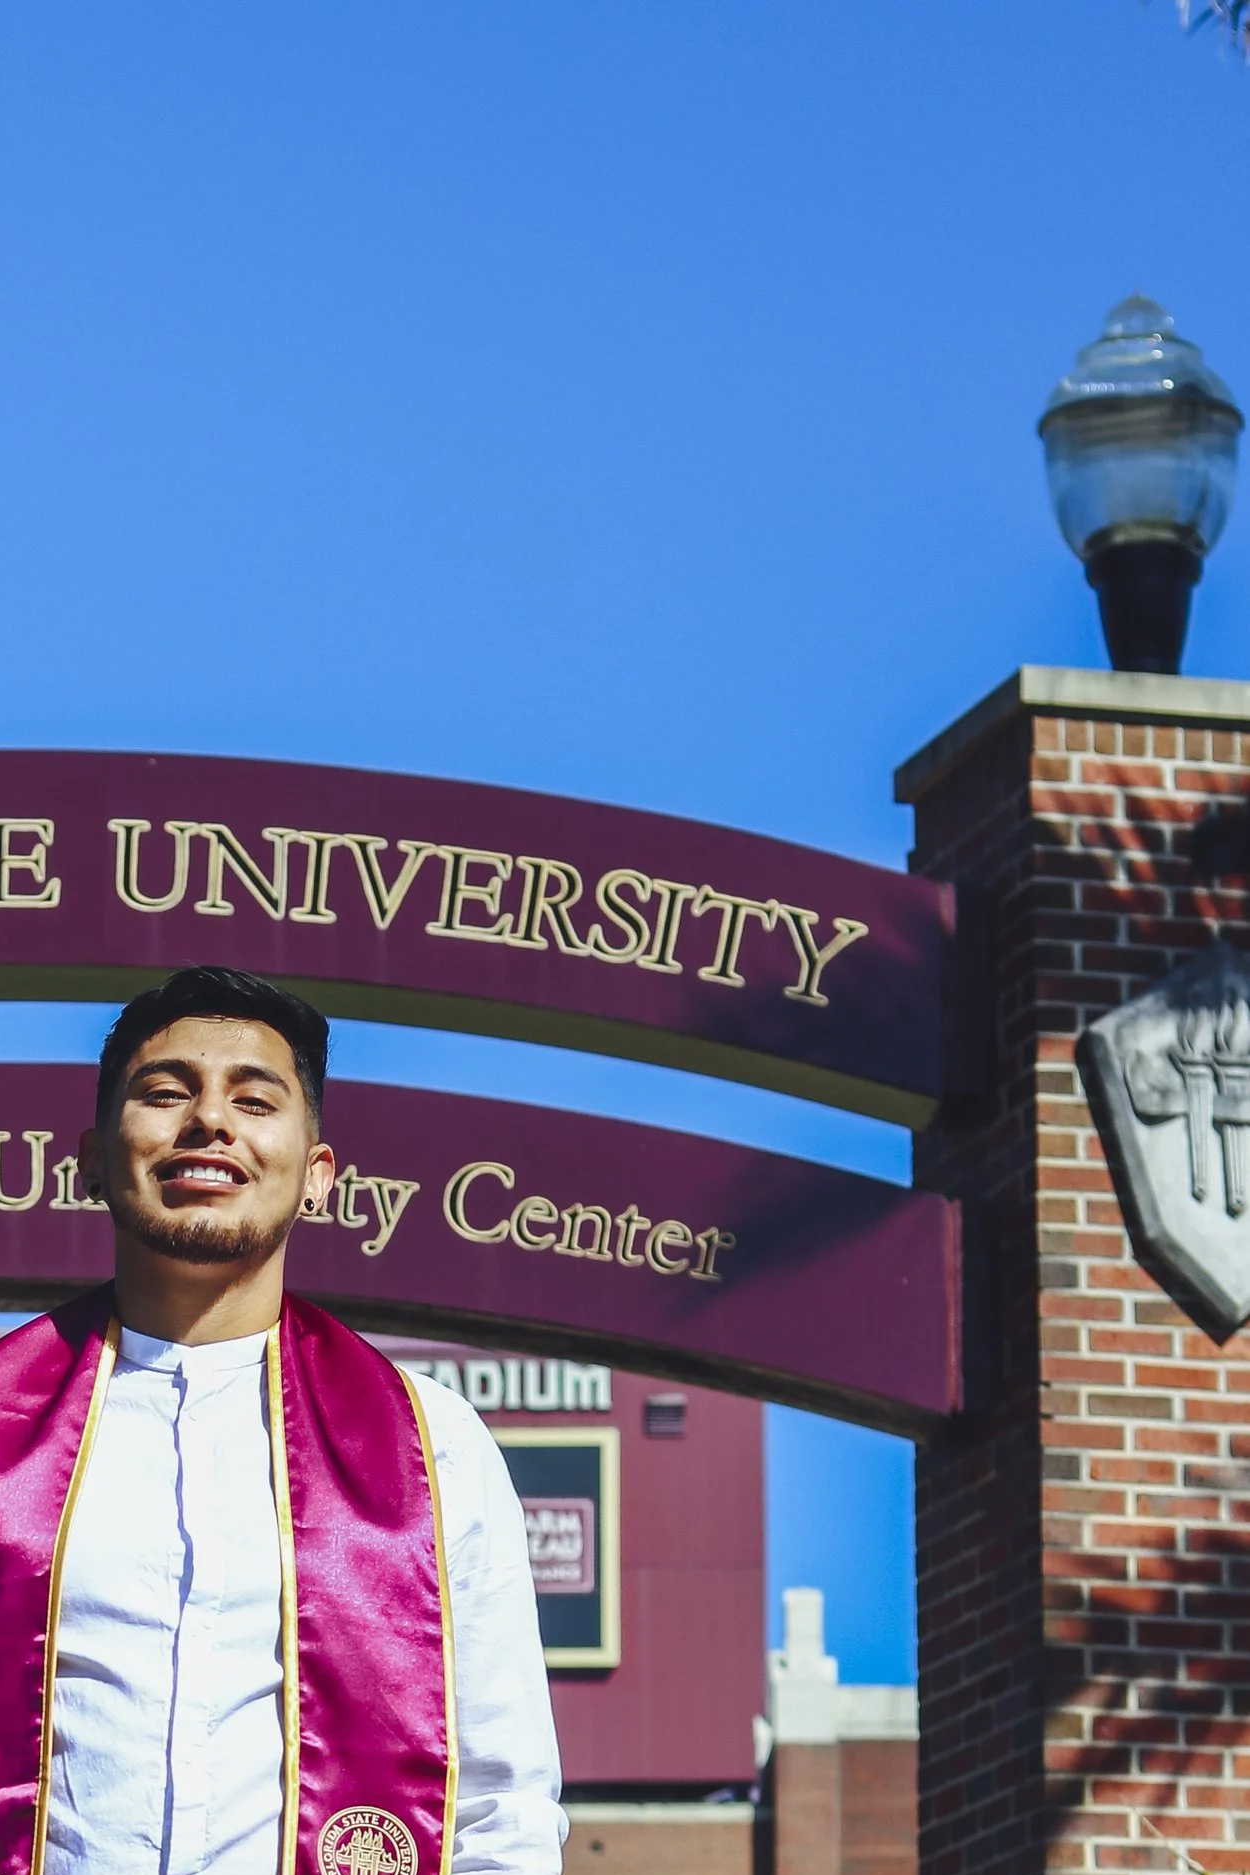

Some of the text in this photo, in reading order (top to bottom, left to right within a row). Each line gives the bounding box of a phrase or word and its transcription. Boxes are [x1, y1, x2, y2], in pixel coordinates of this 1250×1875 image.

[108, 818, 869, 1006] UNIVERSITY
[443, 1161, 737, 1282] Center
[394, 1358, 613, 1411] ADIUM
[341, 1813, 380, 1827] STATE
